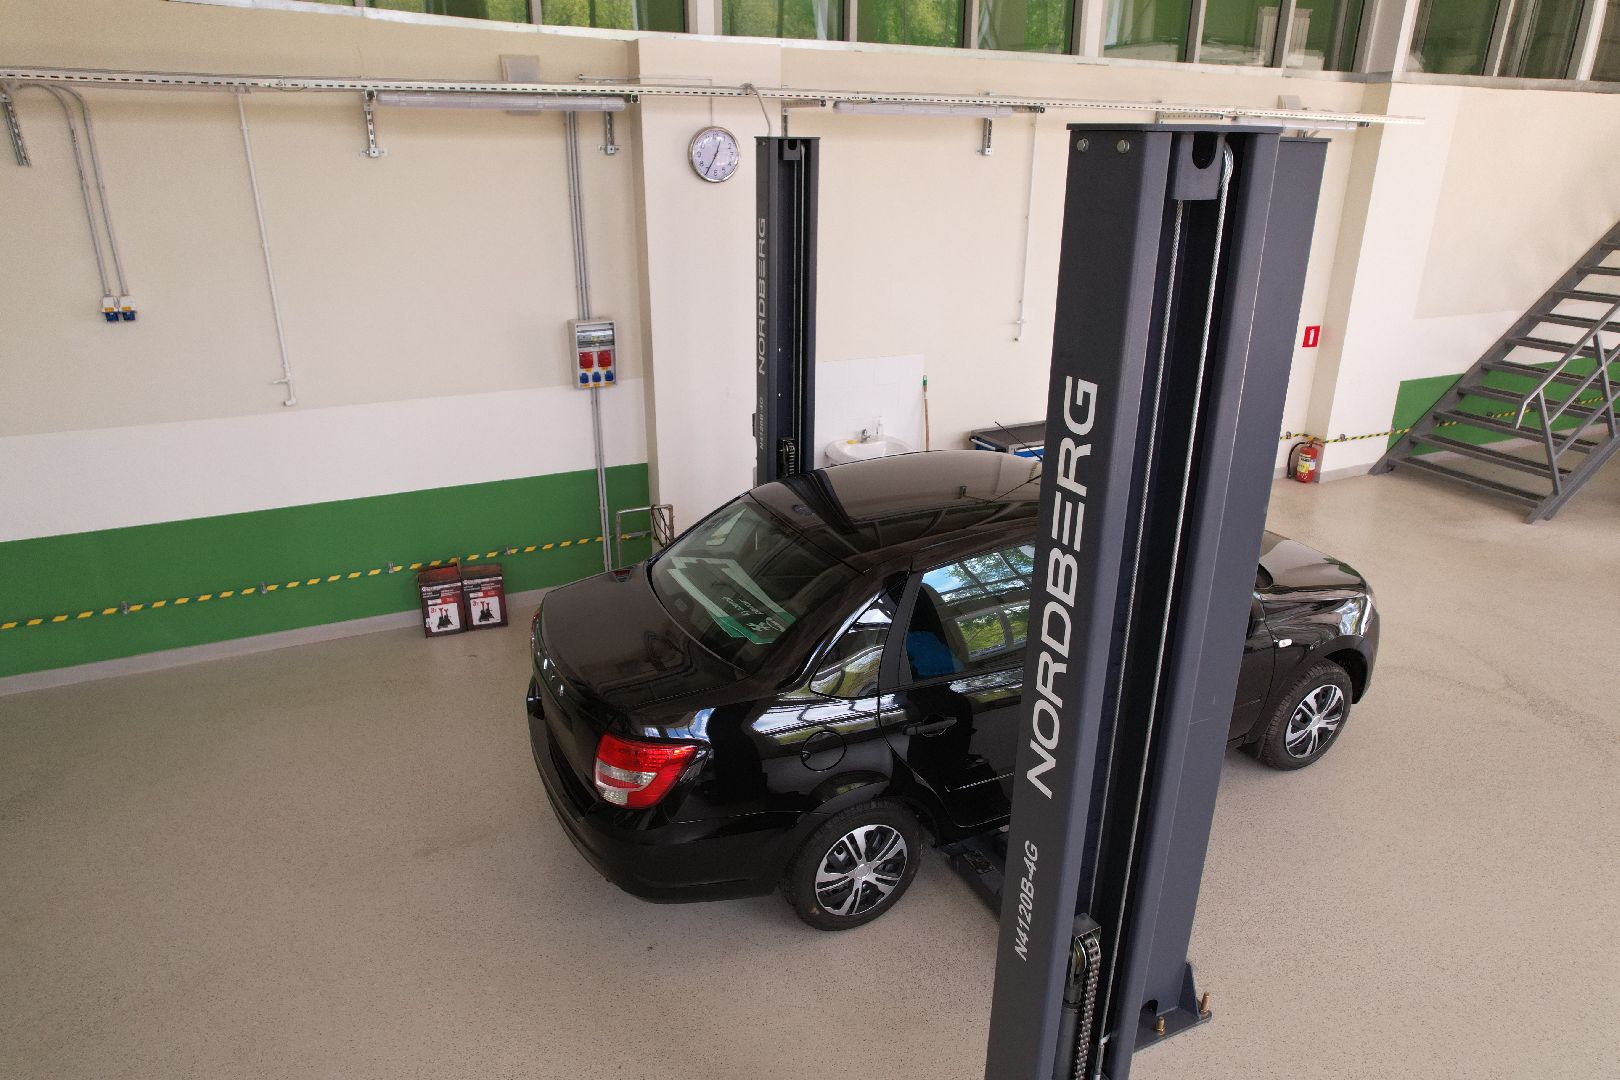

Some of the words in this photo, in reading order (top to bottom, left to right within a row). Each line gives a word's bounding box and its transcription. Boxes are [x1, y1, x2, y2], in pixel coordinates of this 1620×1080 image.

[758, 218, 766, 375] NORDBERG
[1027, 375, 1098, 800] NORDBERG
[1014, 840, 1039, 962] N4120B-4G
